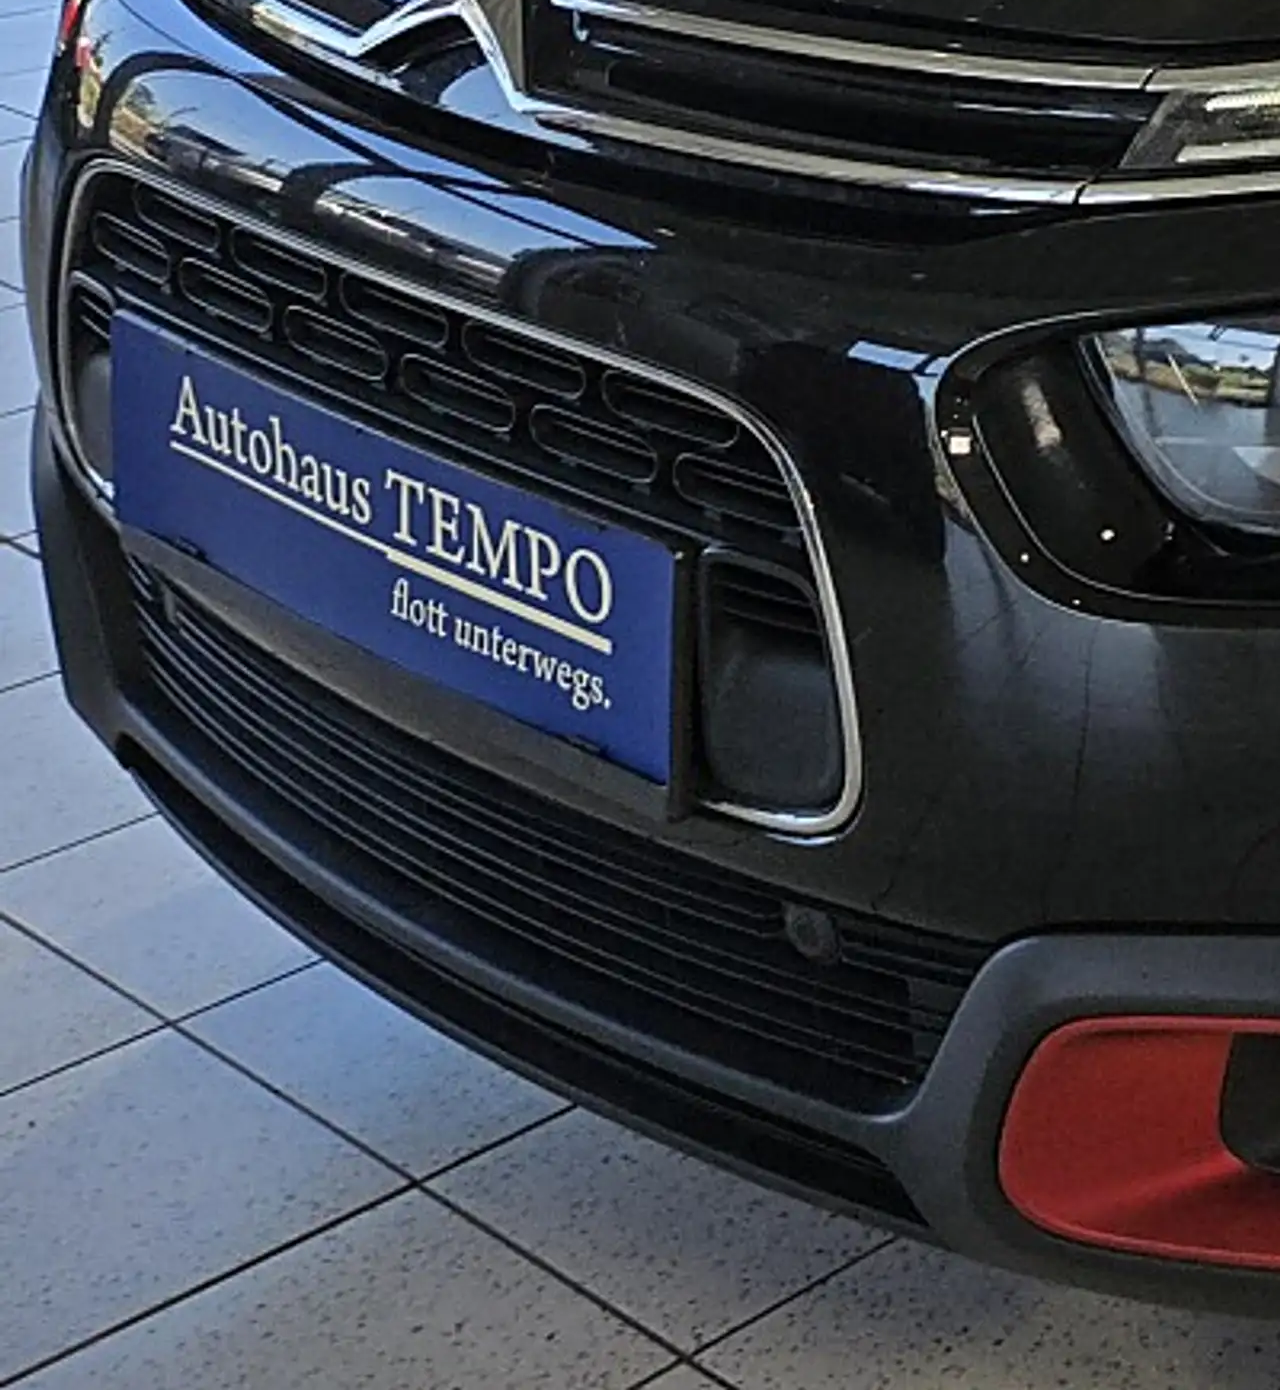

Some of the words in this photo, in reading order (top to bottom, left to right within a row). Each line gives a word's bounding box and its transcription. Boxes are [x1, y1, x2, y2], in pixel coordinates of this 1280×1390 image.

[169, 375, 373, 524] Autohaus
[384, 468, 613, 624] TEMPO
[390, 578, 447, 638] flott
[453, 614, 612, 711] unterwegs.
